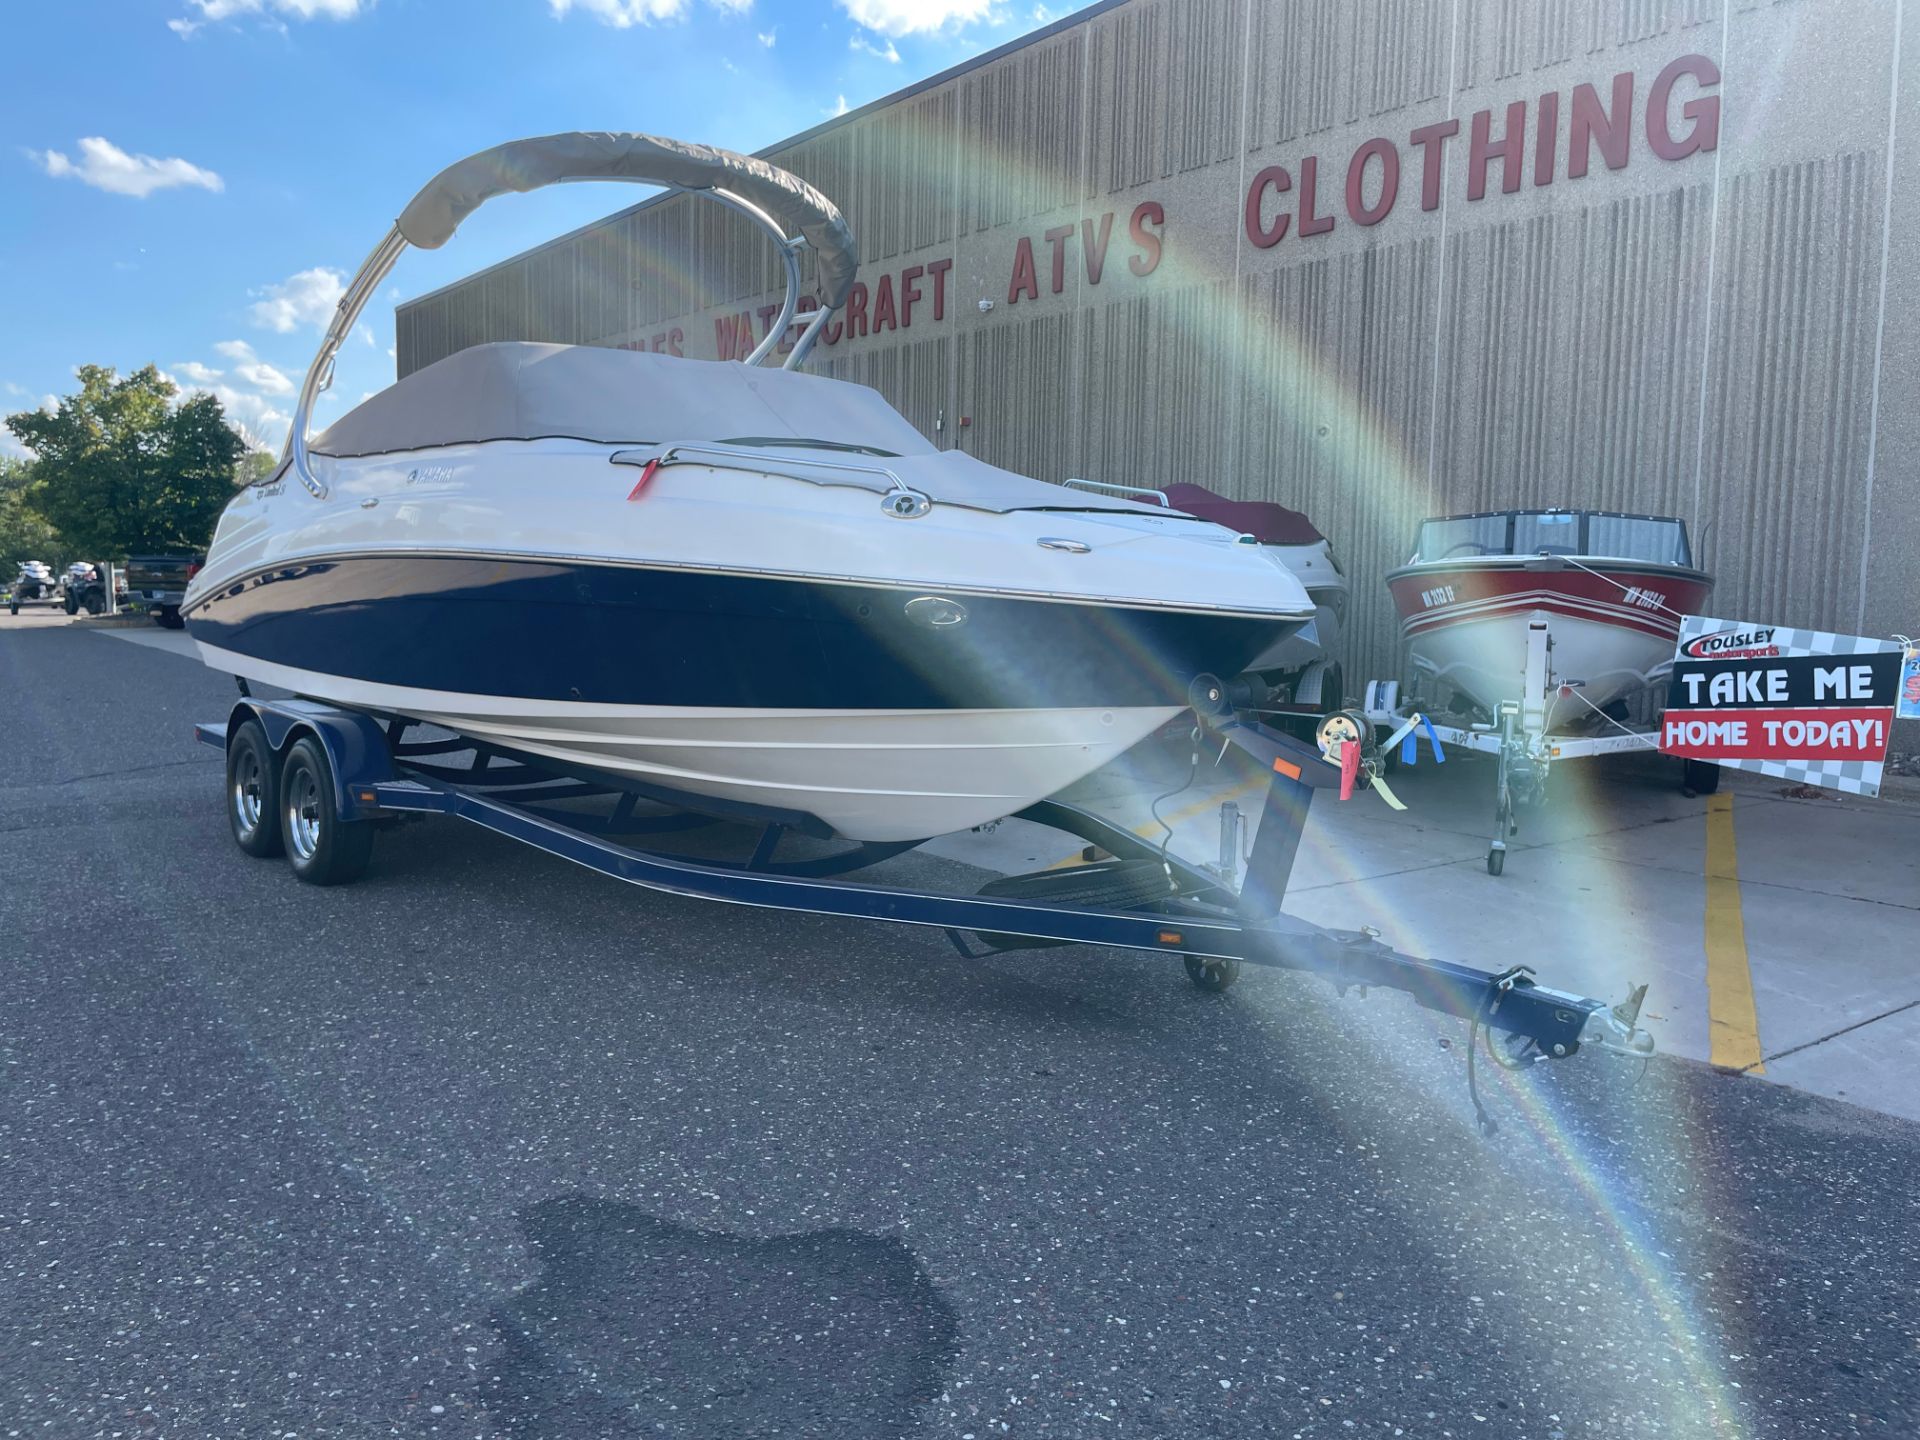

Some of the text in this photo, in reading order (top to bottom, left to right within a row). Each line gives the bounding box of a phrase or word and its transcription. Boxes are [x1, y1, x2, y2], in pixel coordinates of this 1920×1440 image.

[1007, 200, 1165, 304] ATVS
[1245, 53, 1722, 249] CLOTHING
[1700, 628, 1776, 652] TOUSLEY
[1709, 644, 1780, 660] motorsports
[1681, 669, 1789, 707] TAKE
[1813, 665, 1874, 701] ME
[1665, 720, 1749, 749] HOME
[1762, 719, 1883, 750] TODAY!
